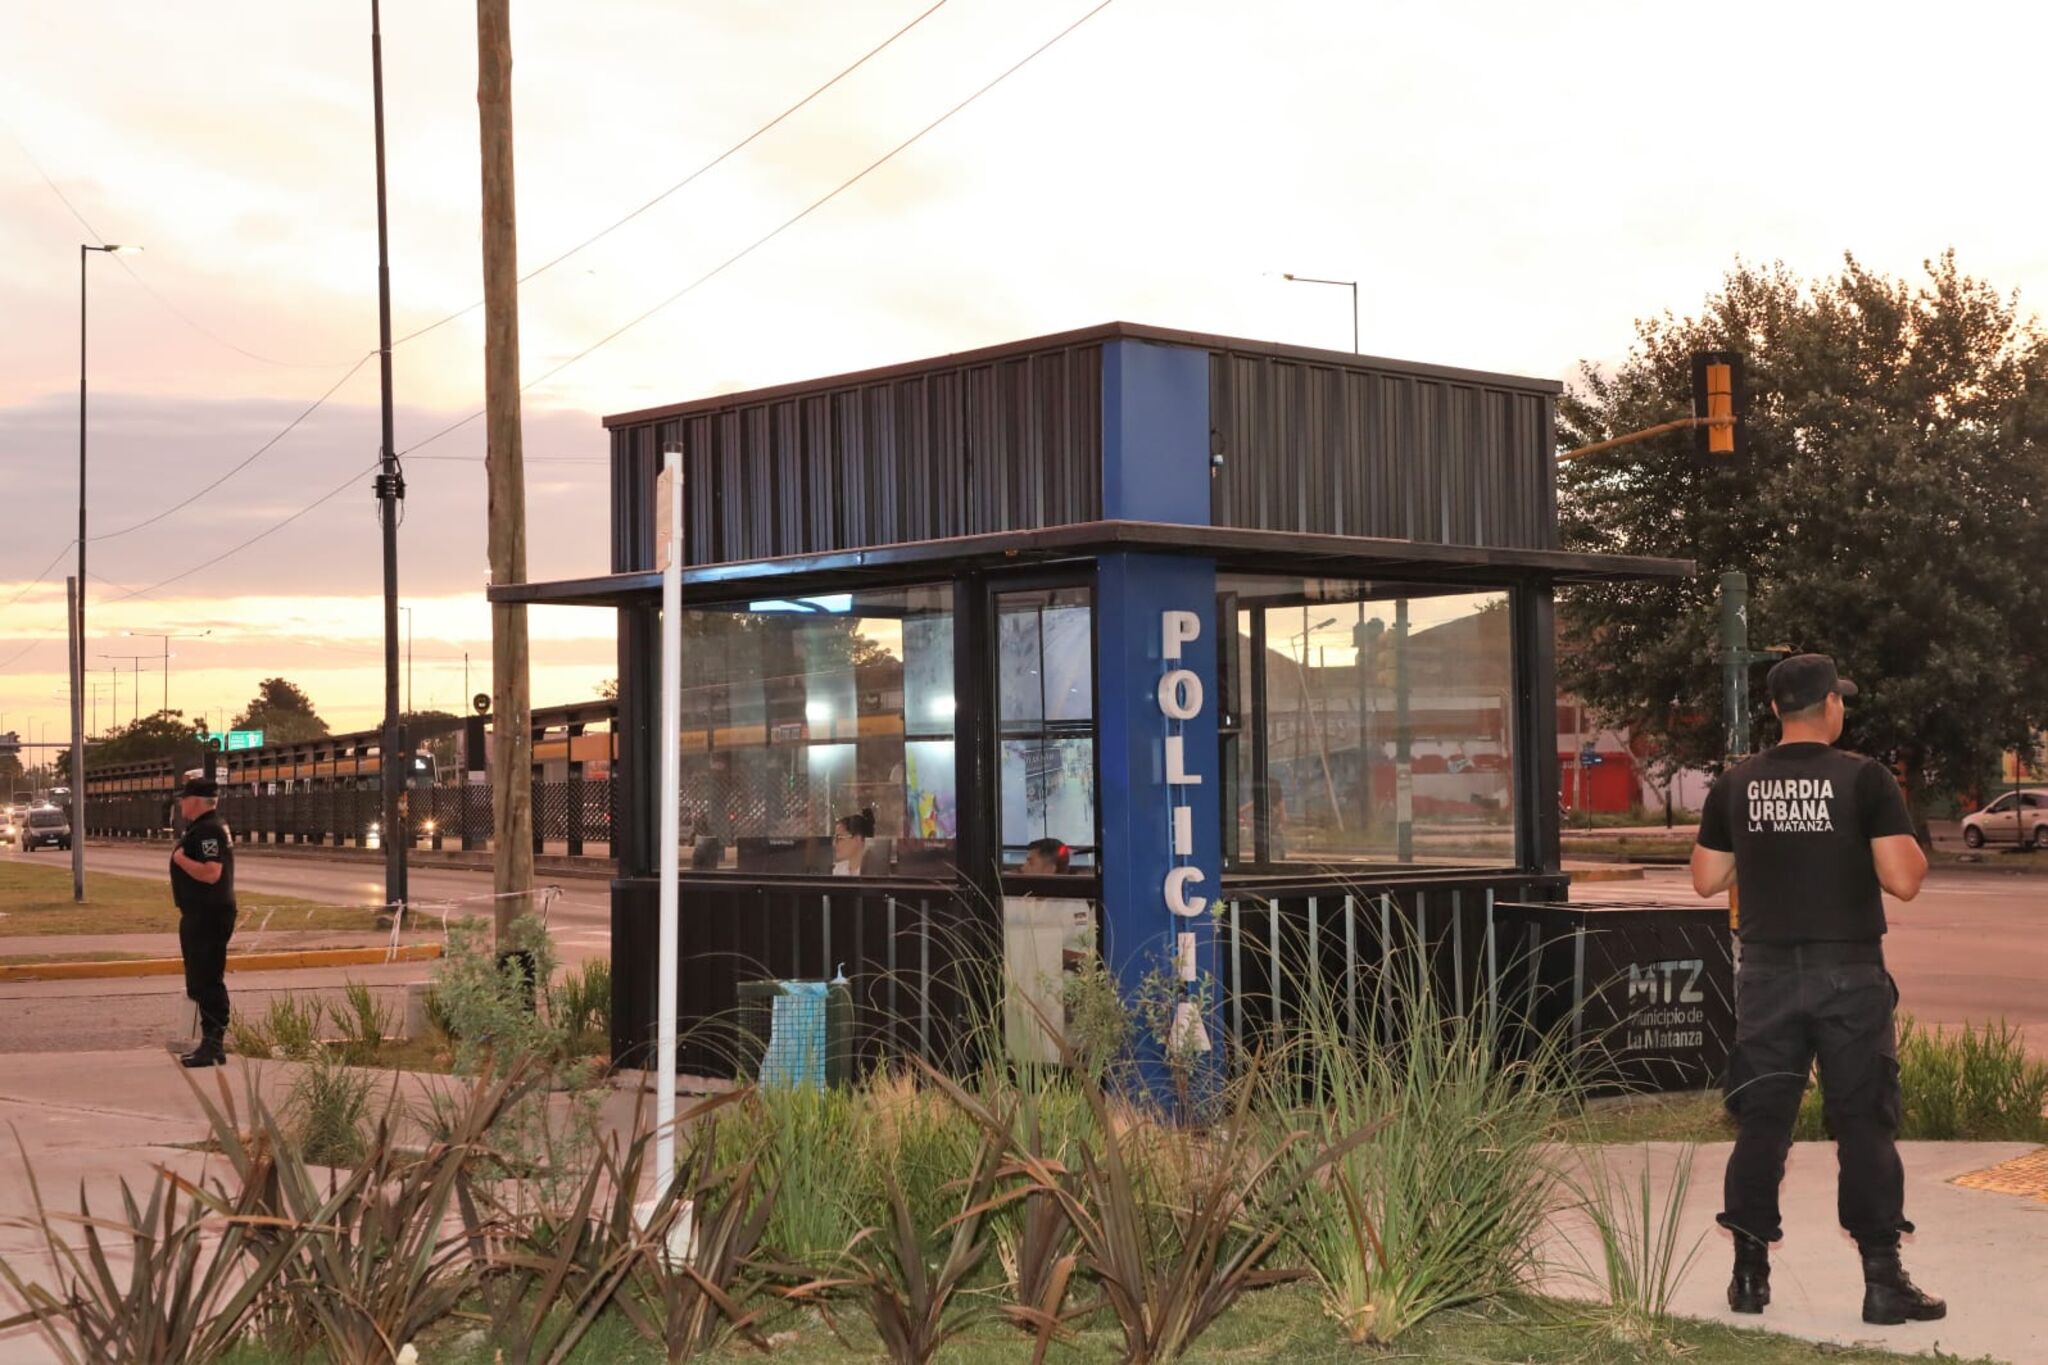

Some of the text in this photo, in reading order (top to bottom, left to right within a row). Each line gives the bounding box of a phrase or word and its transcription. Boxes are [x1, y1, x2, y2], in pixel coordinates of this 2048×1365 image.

[1747, 779, 1834, 800] GUARDIA
[1749, 800, 1830, 821] URBANA
[1158, 610, 1212, 1051] POLICIA
[1748, 820, 1834, 832] LA MATANZA
[1628, 959, 1703, 1005] MTZ
[1687, 1006, 1703, 1023] de
[1627, 1029, 1703, 1050] La Matanza
